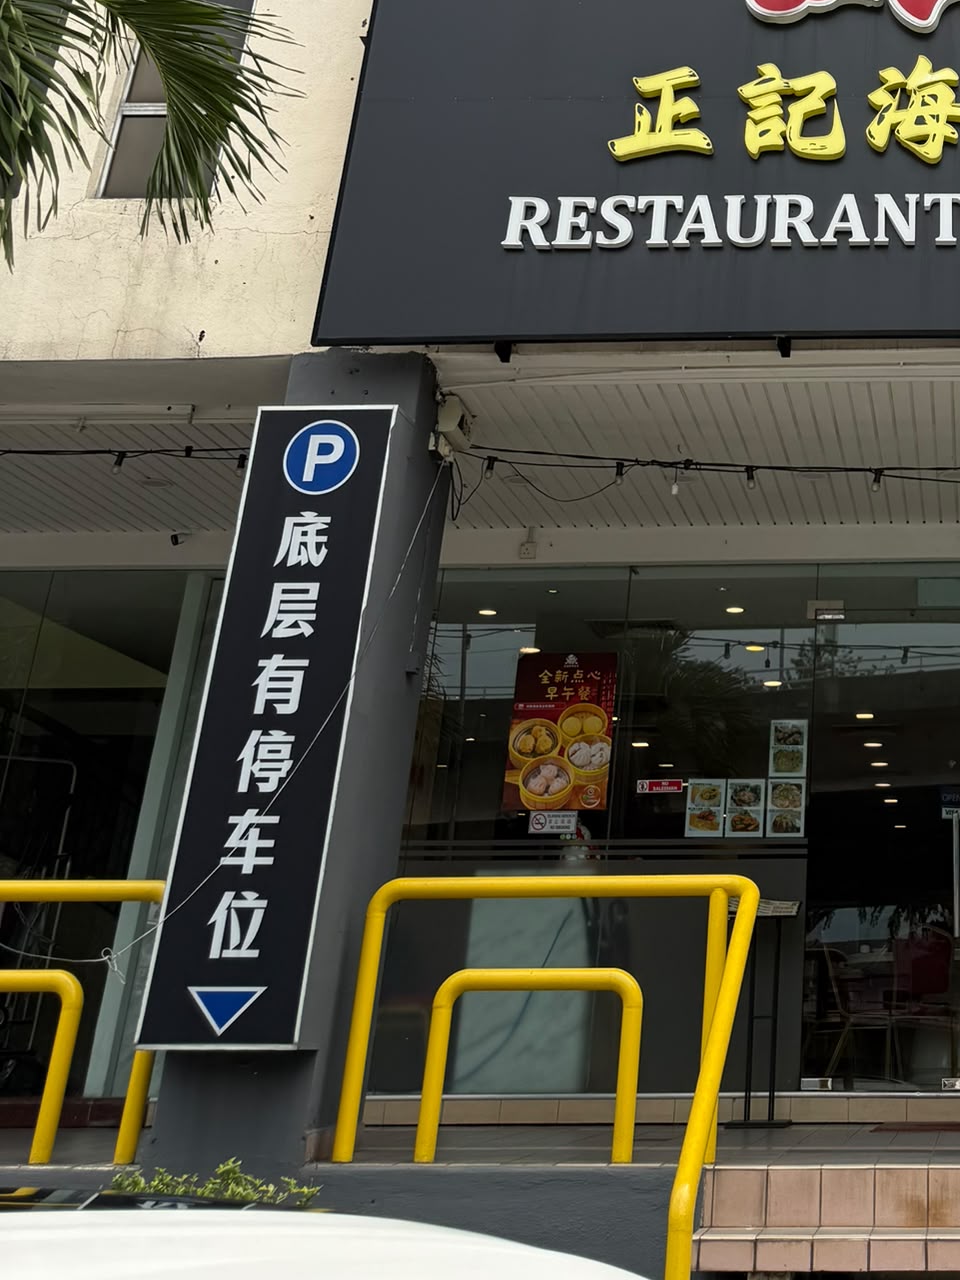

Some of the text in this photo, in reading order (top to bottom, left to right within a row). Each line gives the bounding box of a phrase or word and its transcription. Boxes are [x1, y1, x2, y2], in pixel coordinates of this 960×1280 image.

[301, 434, 345, 482] P
[538, 669, 601, 685] 全新点心
[206, 511, 332, 960] 底层有停车位
